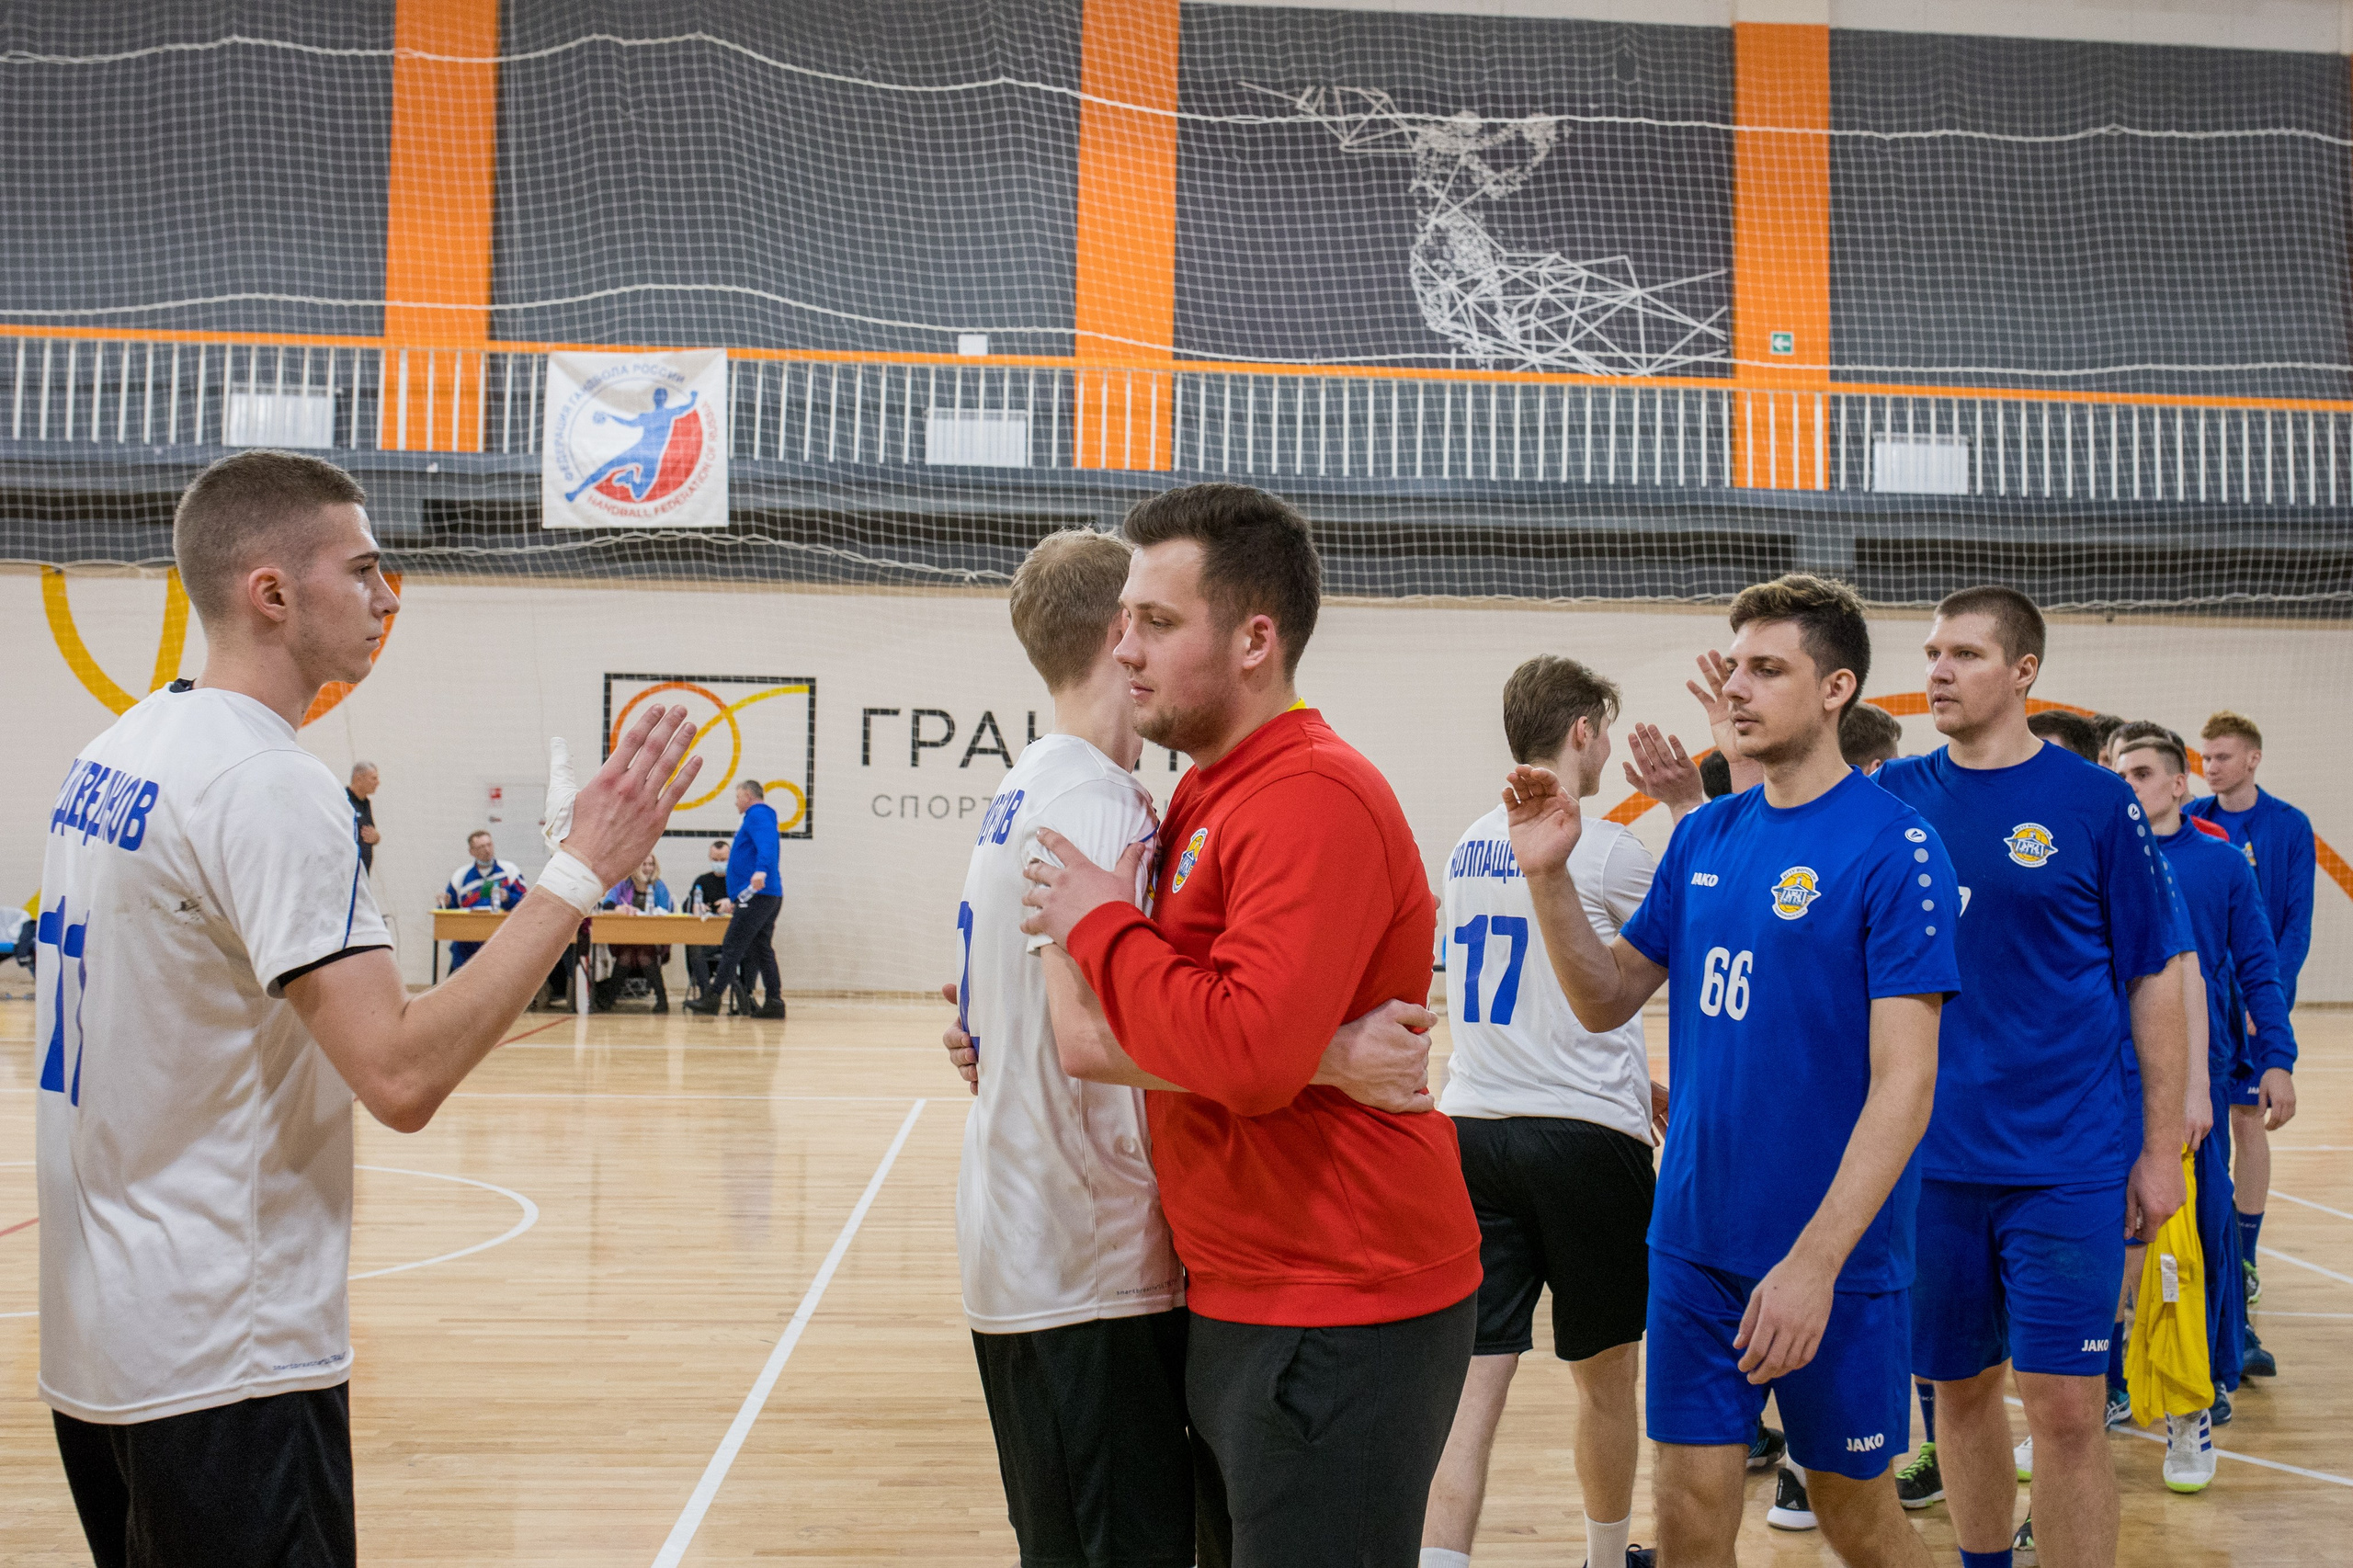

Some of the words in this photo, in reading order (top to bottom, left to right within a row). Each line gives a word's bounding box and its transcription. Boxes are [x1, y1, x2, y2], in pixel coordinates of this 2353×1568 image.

[633, 363, 686, 384] РОССИИ
[587, 494, 653, 517] HANDBALL
[654, 461, 713, 517] FEDERATION
[705, 444, 717, 461] OF
[1690, 871, 1720, 888] JAKO
[1453, 914, 1529, 1026] 17
[1699, 946, 1754, 1022] 66
[2081, 1338, 2109, 1352] JAKO
[1846, 1432, 1884, 1452] JAKO
